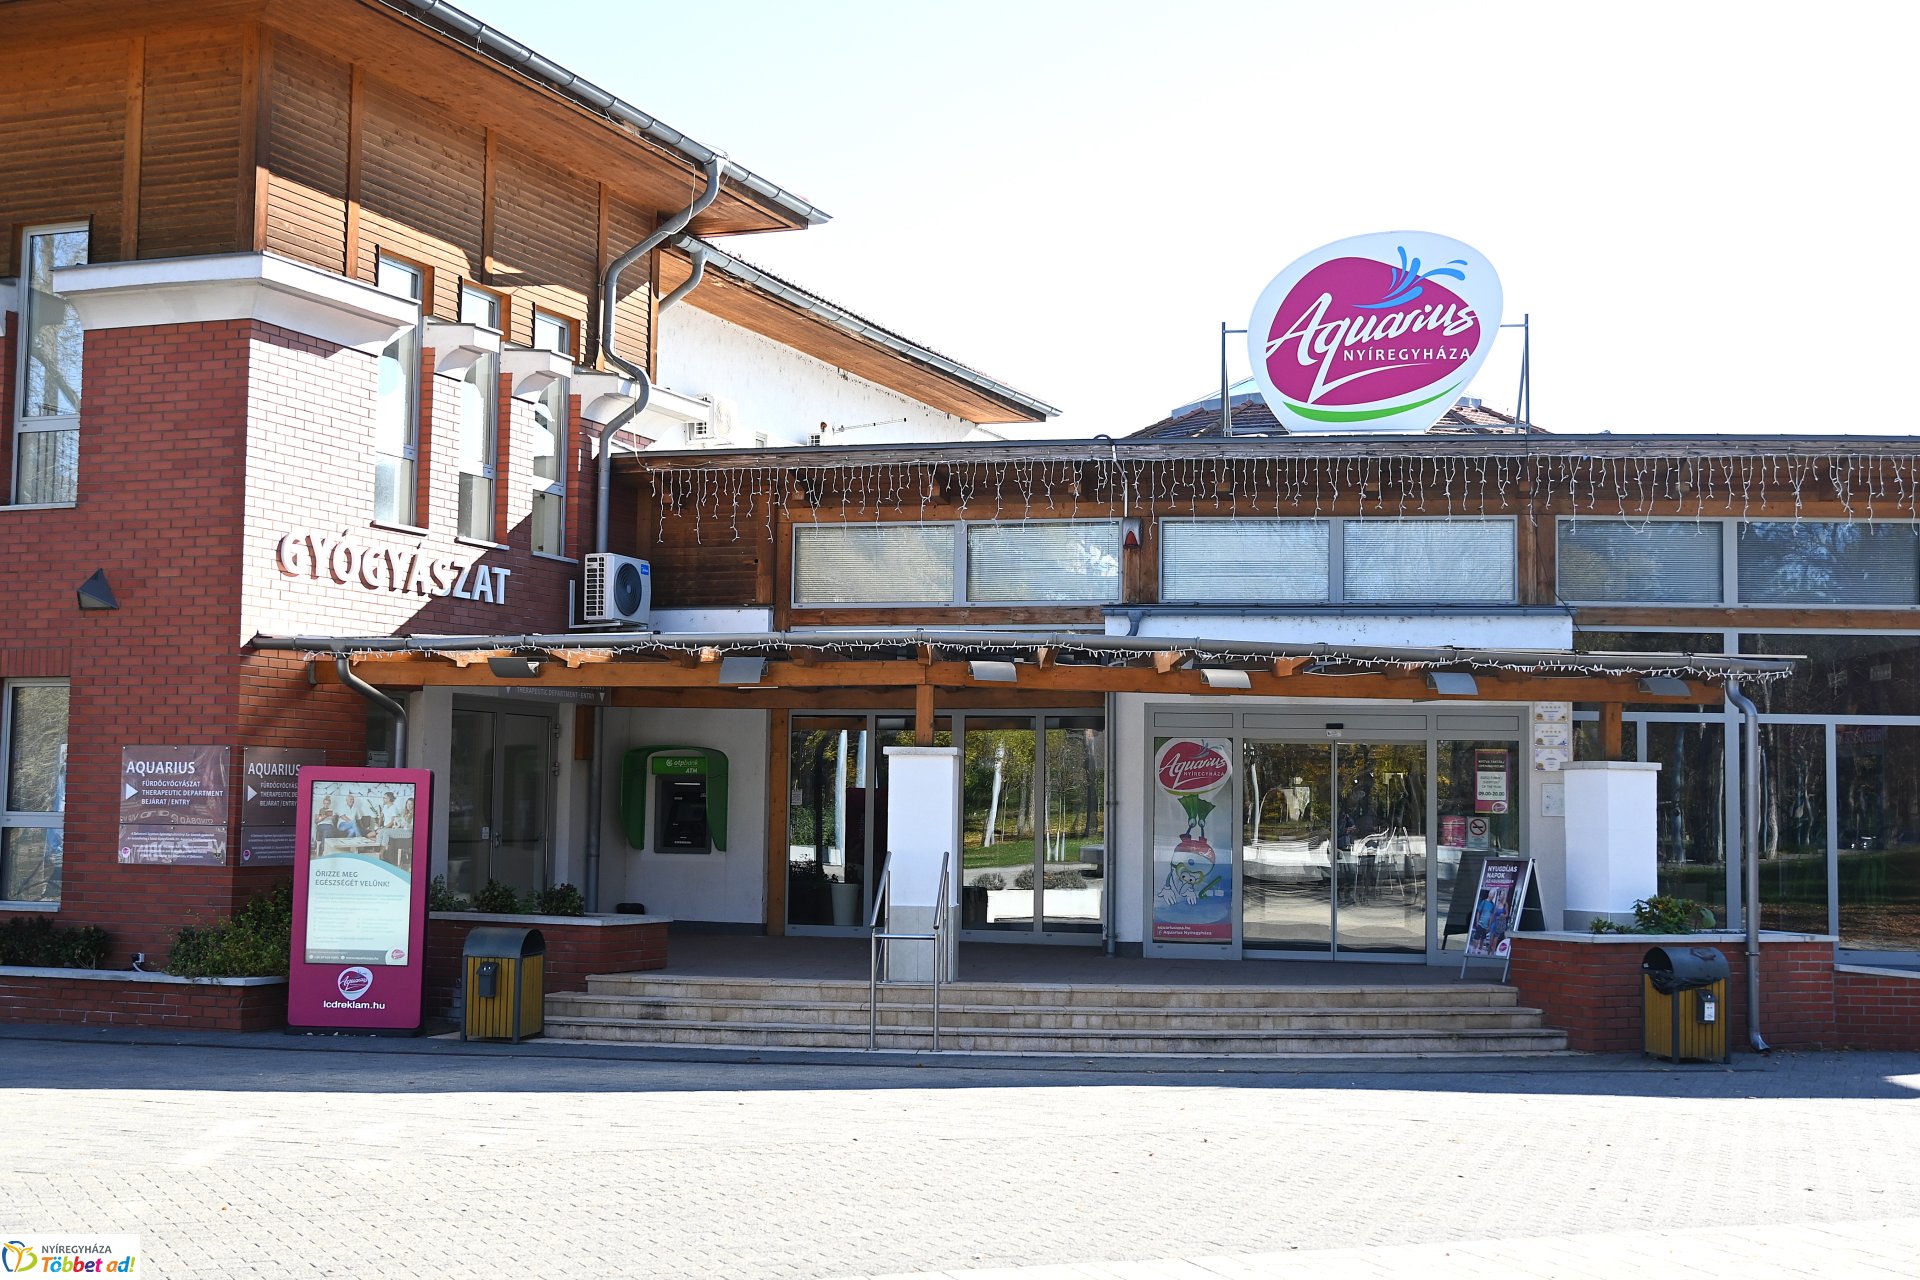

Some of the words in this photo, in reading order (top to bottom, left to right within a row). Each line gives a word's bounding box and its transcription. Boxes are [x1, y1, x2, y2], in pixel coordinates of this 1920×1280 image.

[1265, 292, 1478, 405] Aquarius
[1343, 345, 1470, 361] NYÍREGYHÁZA
[277, 529, 511, 605] GYÓGYÁSZAT
[126, 761, 196, 777] AQUARIUS
[247, 762, 301, 779] AQUARIUS
[1159, 752, 1226, 790] Aquarius
[141, 797, 167, 805] BEJÁRAT
[315, 870, 341, 878] ŐRIZZE
[1487, 864, 1518, 873] NYUGDÍJAS
[315, 879, 359, 887] EGÉSZSÉGÉT
[359, 880, 390, 888] VELÜNK!
